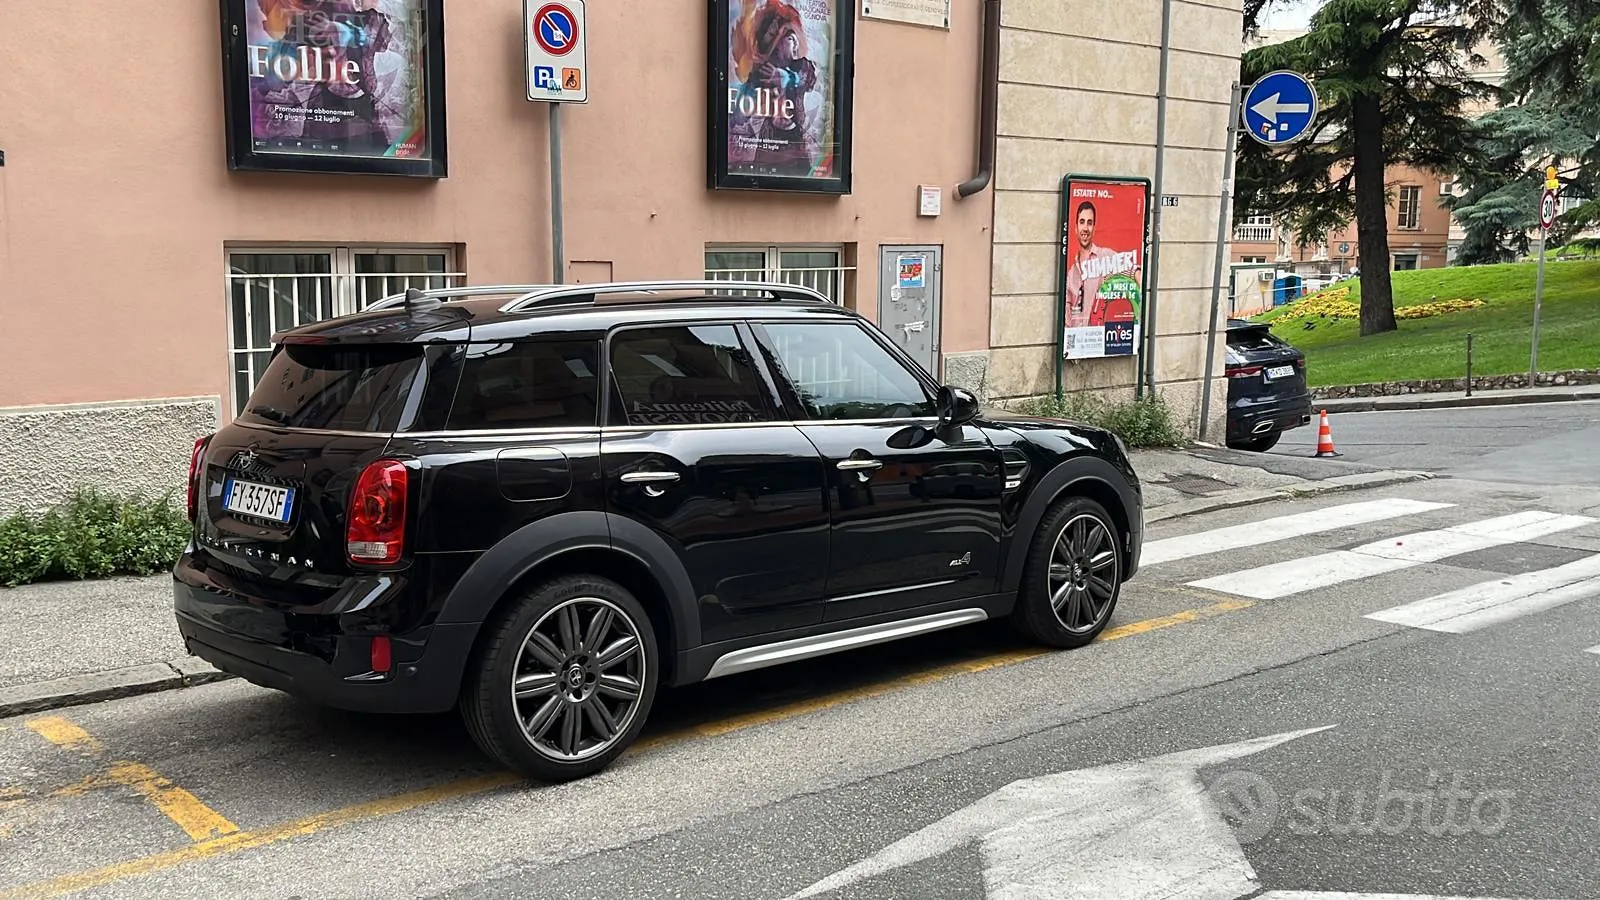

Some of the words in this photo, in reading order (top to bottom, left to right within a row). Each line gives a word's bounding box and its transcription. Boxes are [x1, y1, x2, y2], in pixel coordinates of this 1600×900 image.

[248, 44, 360, 84] Follie
[538, 69, 550, 86] P
[274, 105, 313, 115] Promozione
[314, 107, 355, 117] abbonamenti
[728, 87, 795, 119] Follie
[284, 113, 306, 121] giugno
[323, 115, 341, 123] luglio
[1544, 200, 1552, 218] 30
[1081, 249, 1137, 280] SUMMER!
